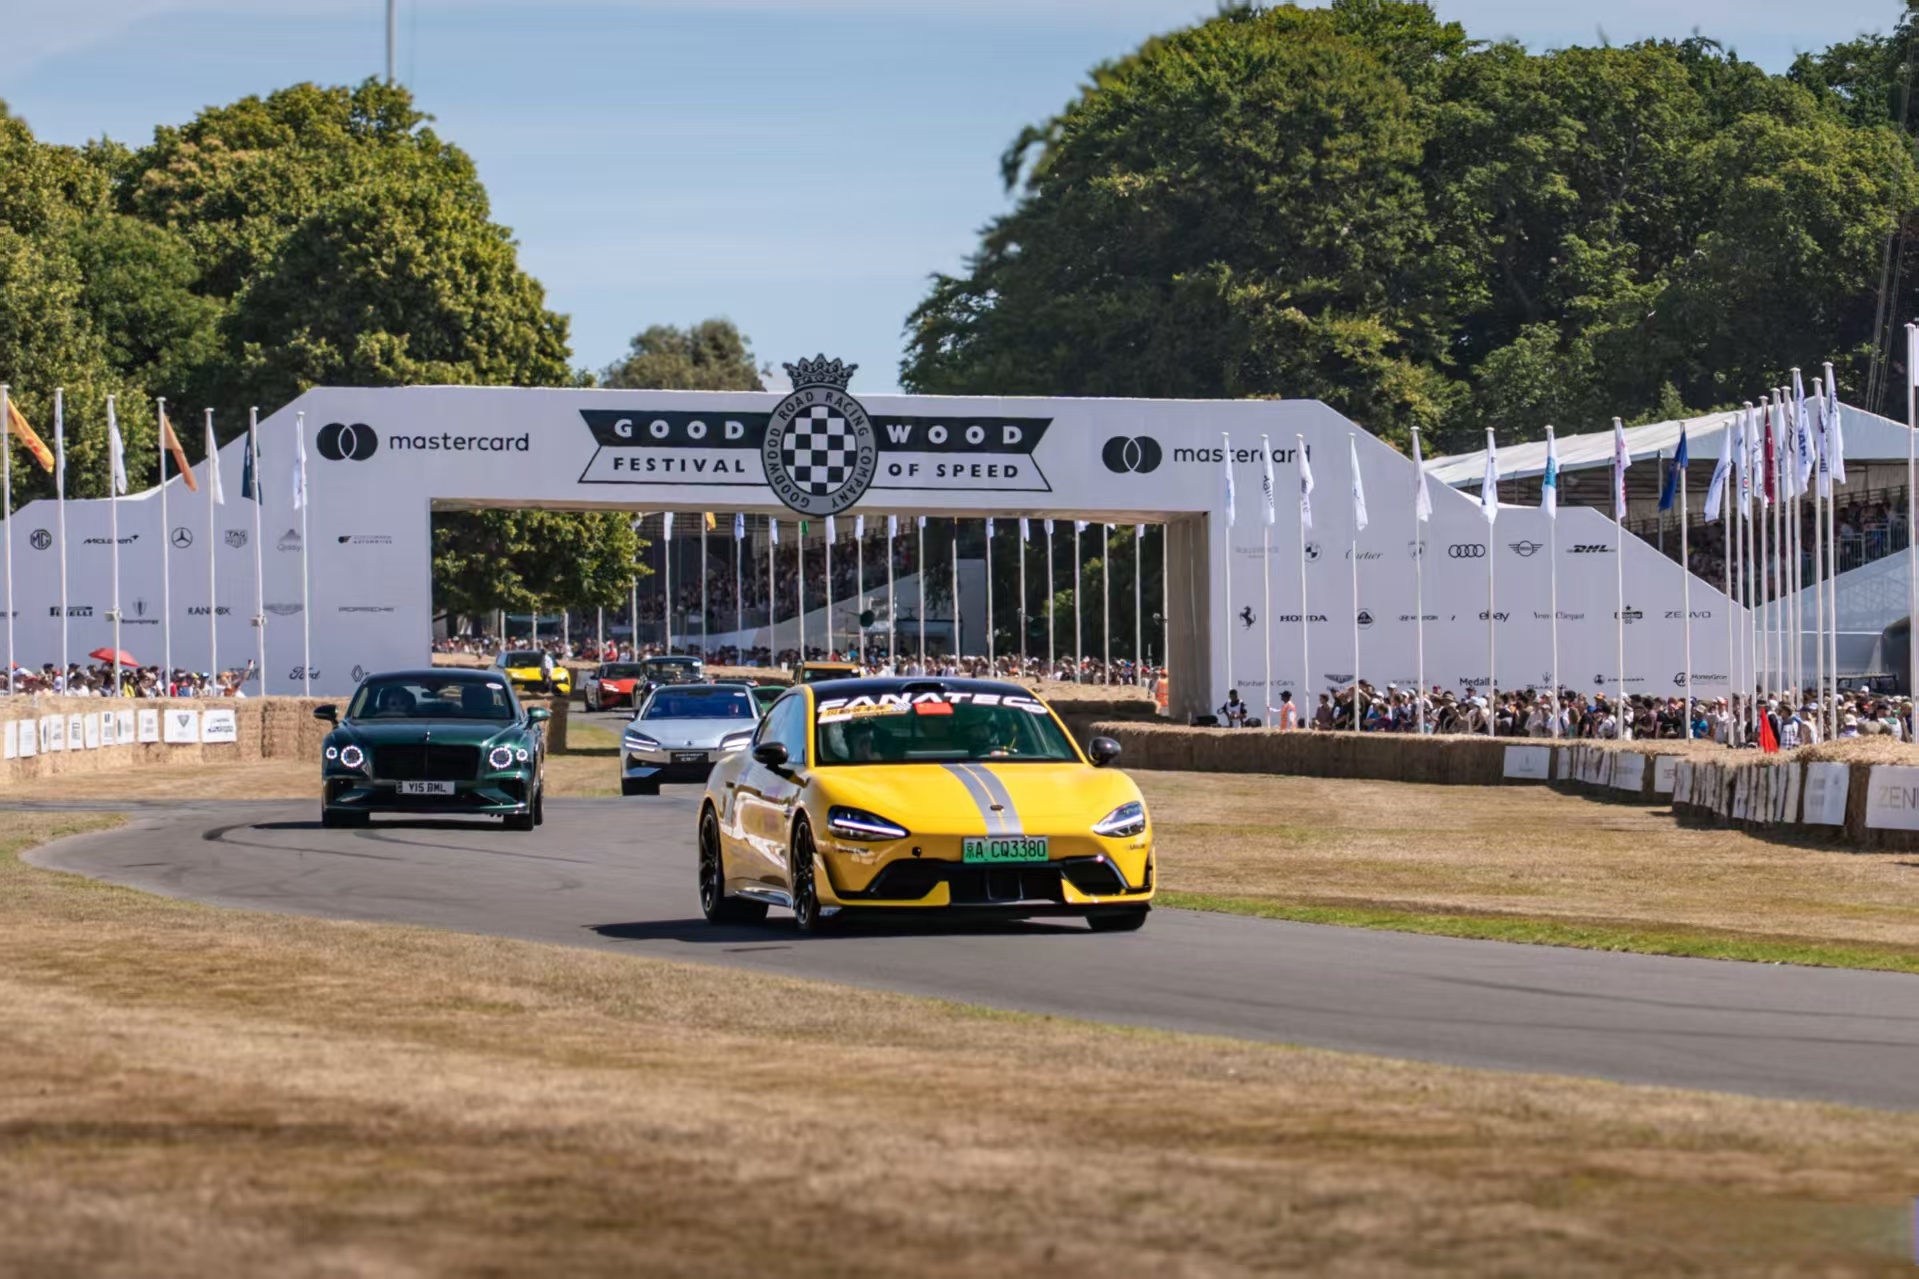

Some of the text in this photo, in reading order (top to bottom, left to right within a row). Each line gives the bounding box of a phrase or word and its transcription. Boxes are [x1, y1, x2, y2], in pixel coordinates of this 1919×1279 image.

[614, 418, 1023, 445] GOOD WOOD
[389, 433, 529, 451] mastercard
[767, 391, 872, 508] GOODWOOD ROAD RACING COMPANY
[614, 457, 745, 473] FESTIVAL
[888, 463, 1018, 478] OF SPEED
[1573, 545, 1609, 553] DHL
[187, 607, 231, 616] RANOX
[1459, 678, 1498, 686] Medalla
[817, 692, 1048, 714] FANATEC
[991, 840, 1047, 859] CQ3380
